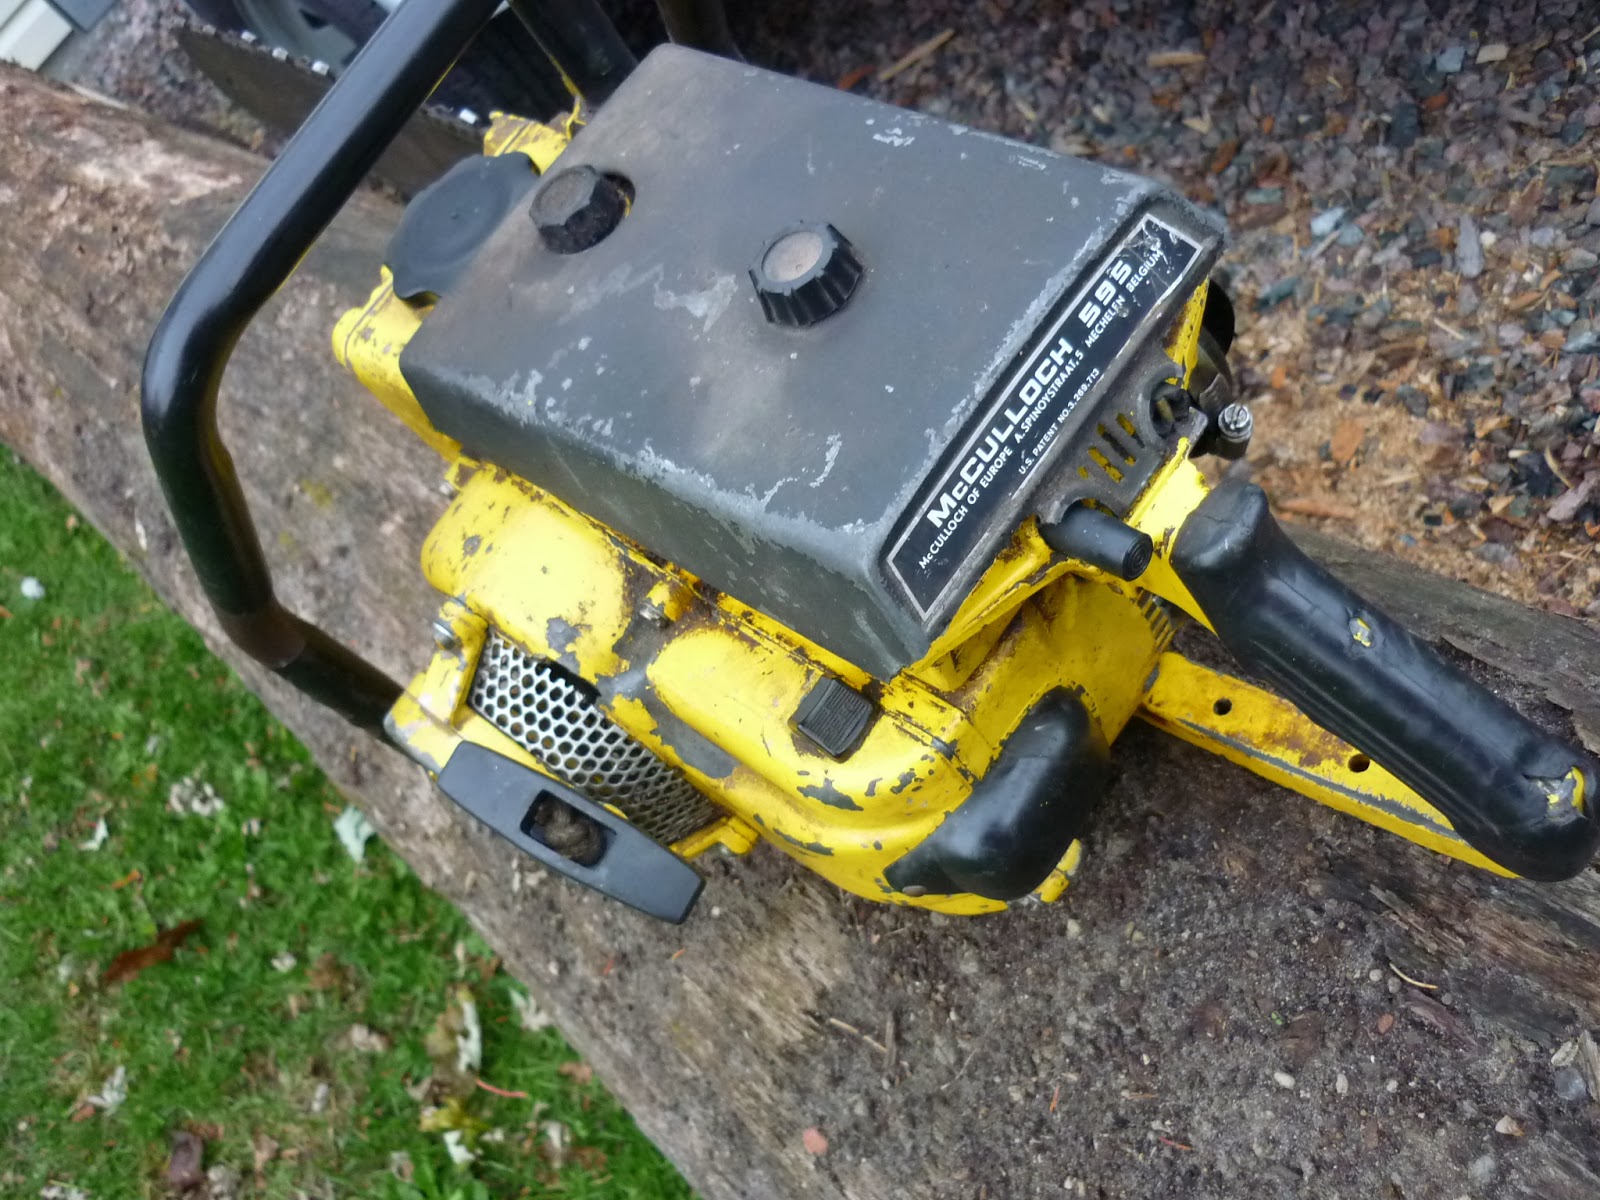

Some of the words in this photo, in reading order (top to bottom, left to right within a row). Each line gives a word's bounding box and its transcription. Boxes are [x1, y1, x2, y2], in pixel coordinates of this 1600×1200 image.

[918, 505, 970, 570] McCULLOCH
[965, 486, 982, 506] OF
[978, 445, 1014, 490] EUROPE
[1084, 293, 1127, 348] MECHELEN
[1125, 248, 1165, 294] BELGIUM
[925, 336, 1074, 529] McCULLOCH
[1076, 258, 1134, 329] 595
[1017, 456, 1036, 476] U.S.
[1031, 421, 1059, 457] PATENT
